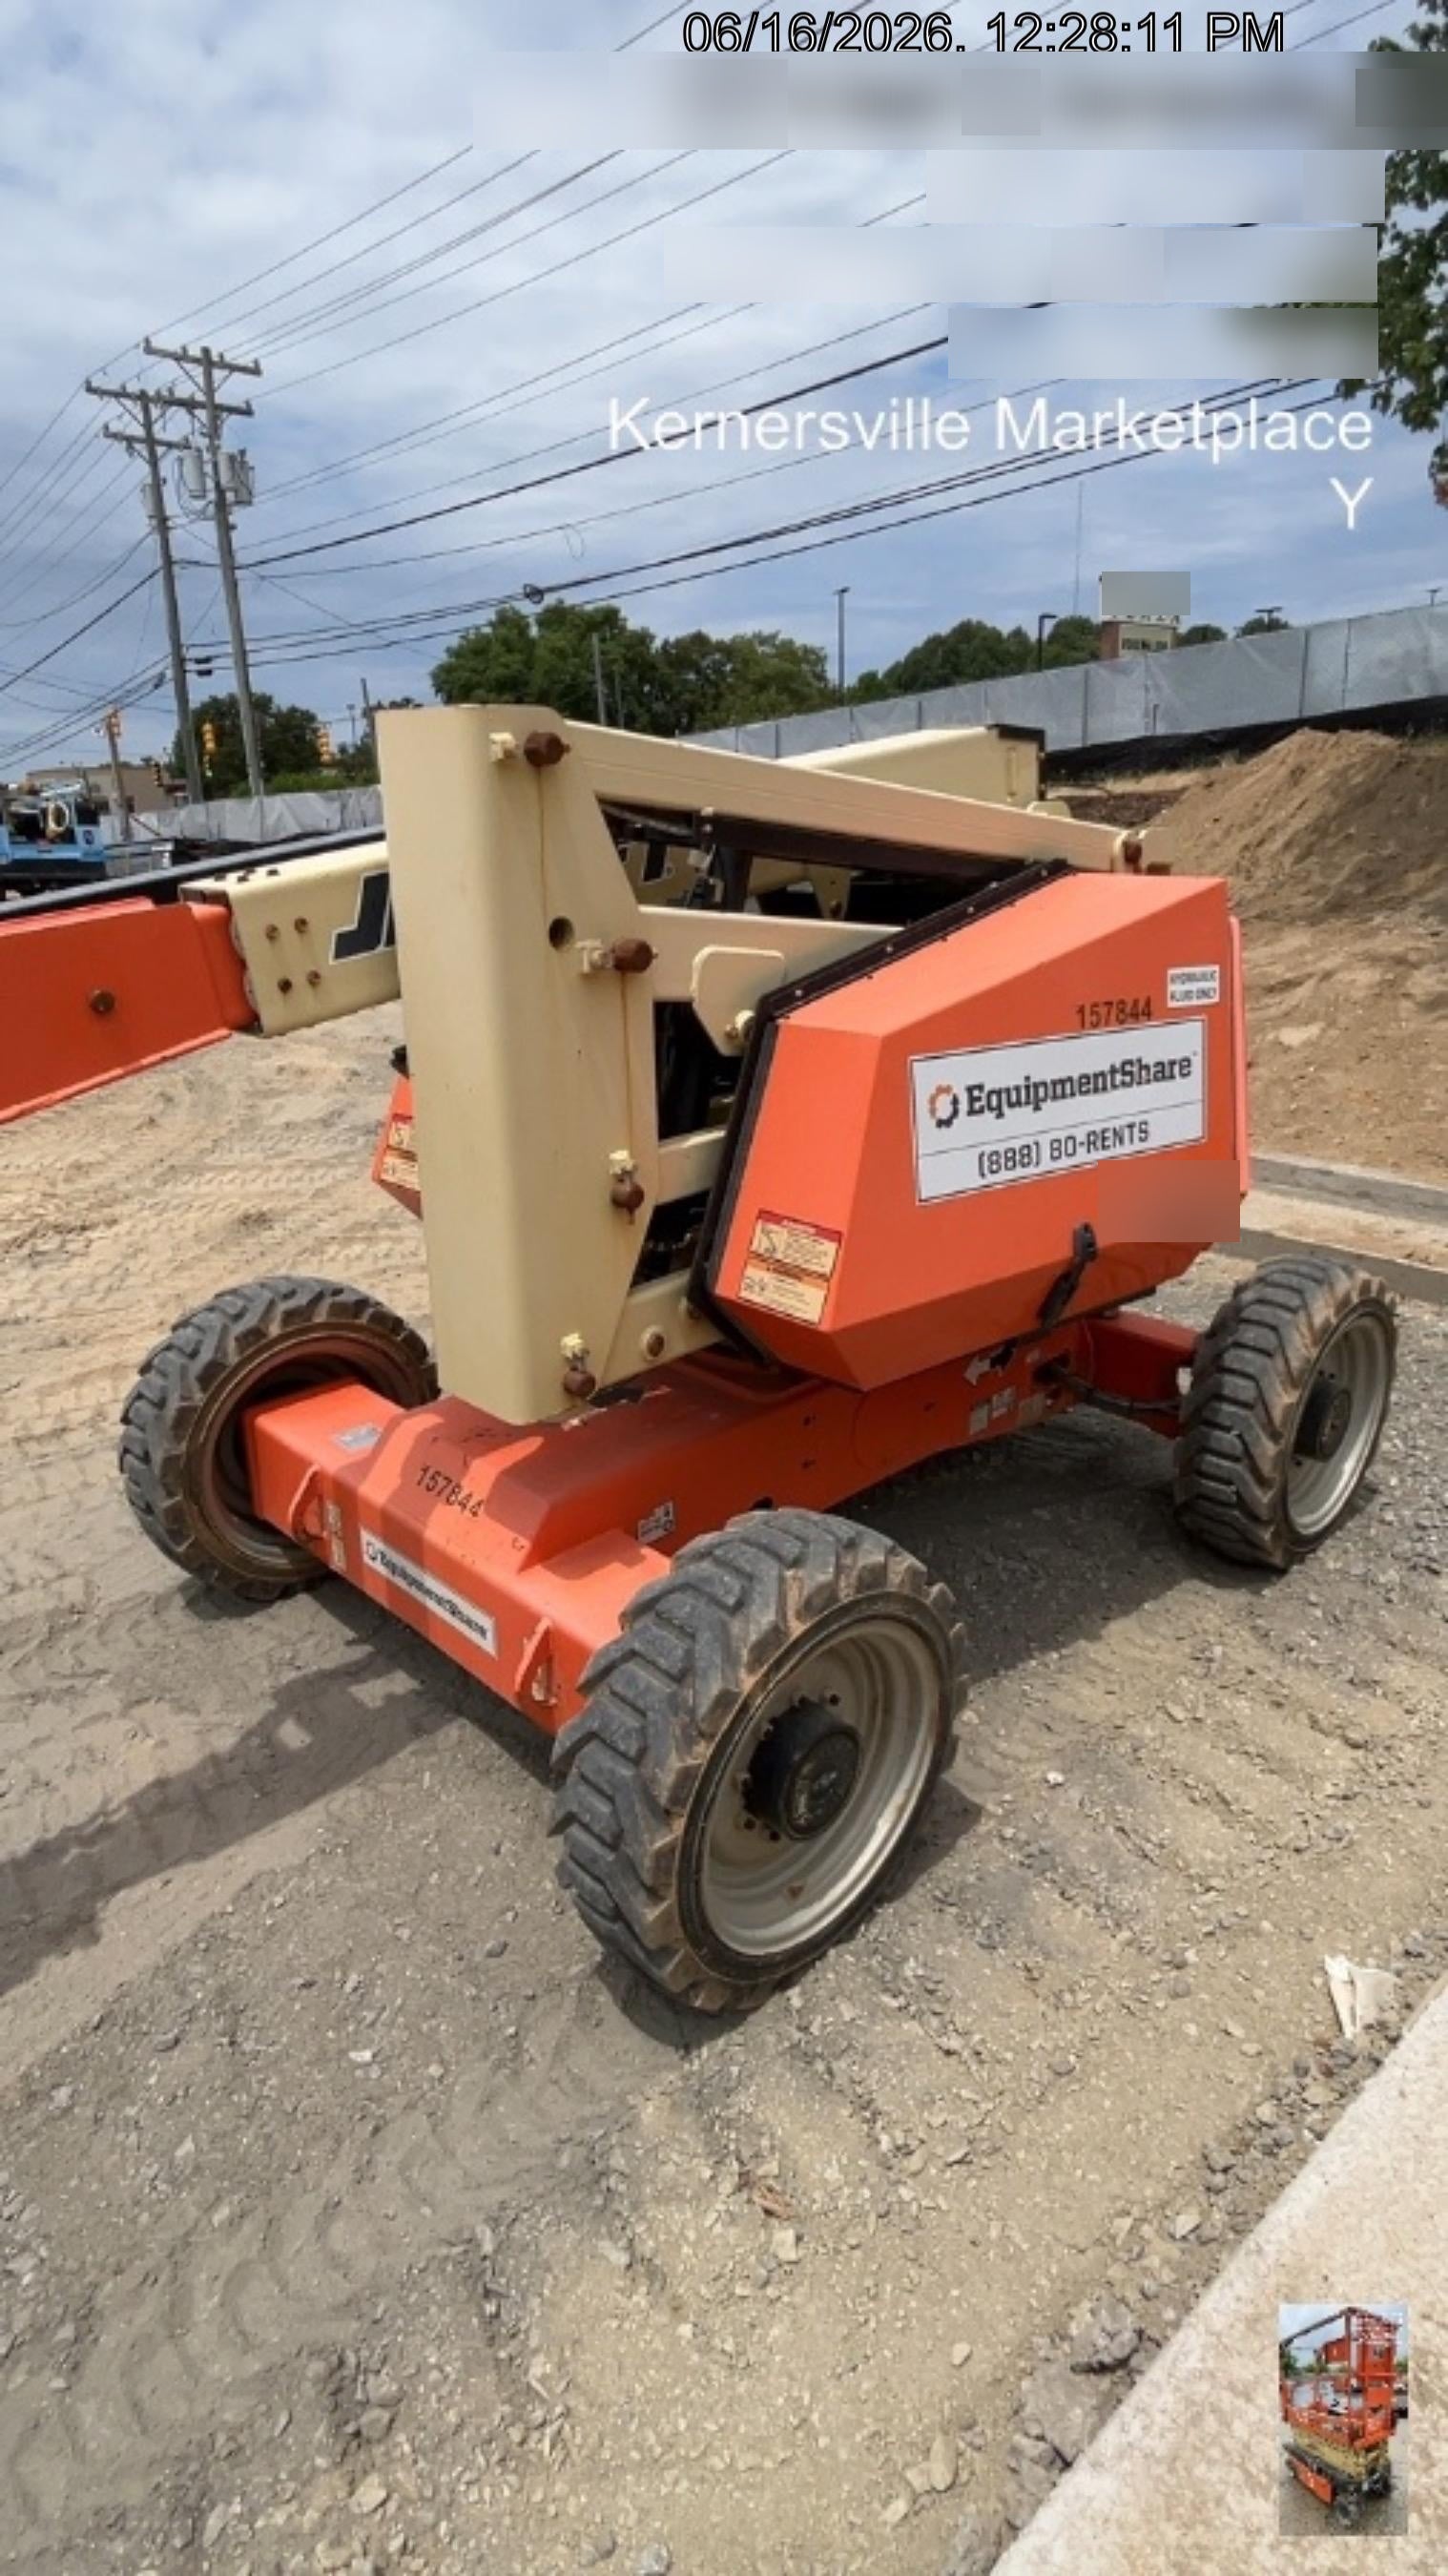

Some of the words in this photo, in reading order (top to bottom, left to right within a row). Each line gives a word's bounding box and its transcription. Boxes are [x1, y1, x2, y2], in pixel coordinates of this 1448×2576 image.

[1075, 996, 1152, 1029] 157844
[965, 1054, 1192, 1119] EquipmentShare
[978, 1139, 1041, 1179] (888)
